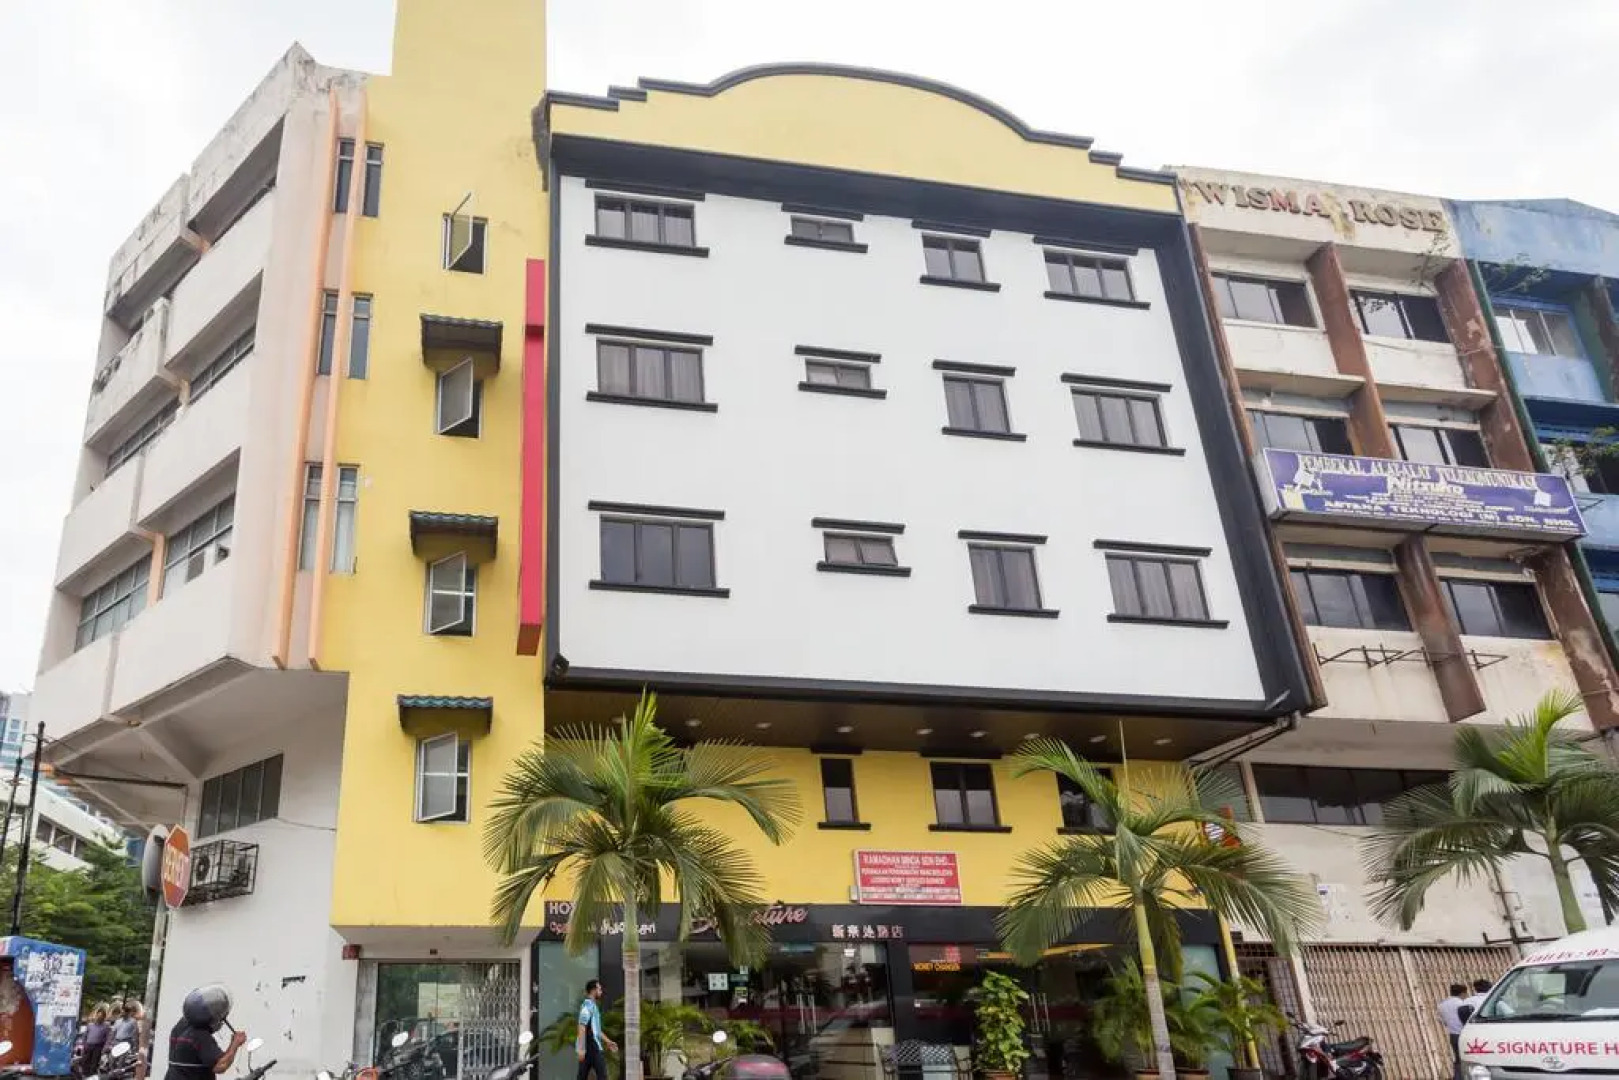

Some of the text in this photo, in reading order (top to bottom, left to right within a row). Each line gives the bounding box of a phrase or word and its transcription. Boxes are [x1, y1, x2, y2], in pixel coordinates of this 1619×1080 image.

[1193, 182, 1444, 232] WISMA ROSE
[1496, 1041, 1598, 1056] SIGNATURE
